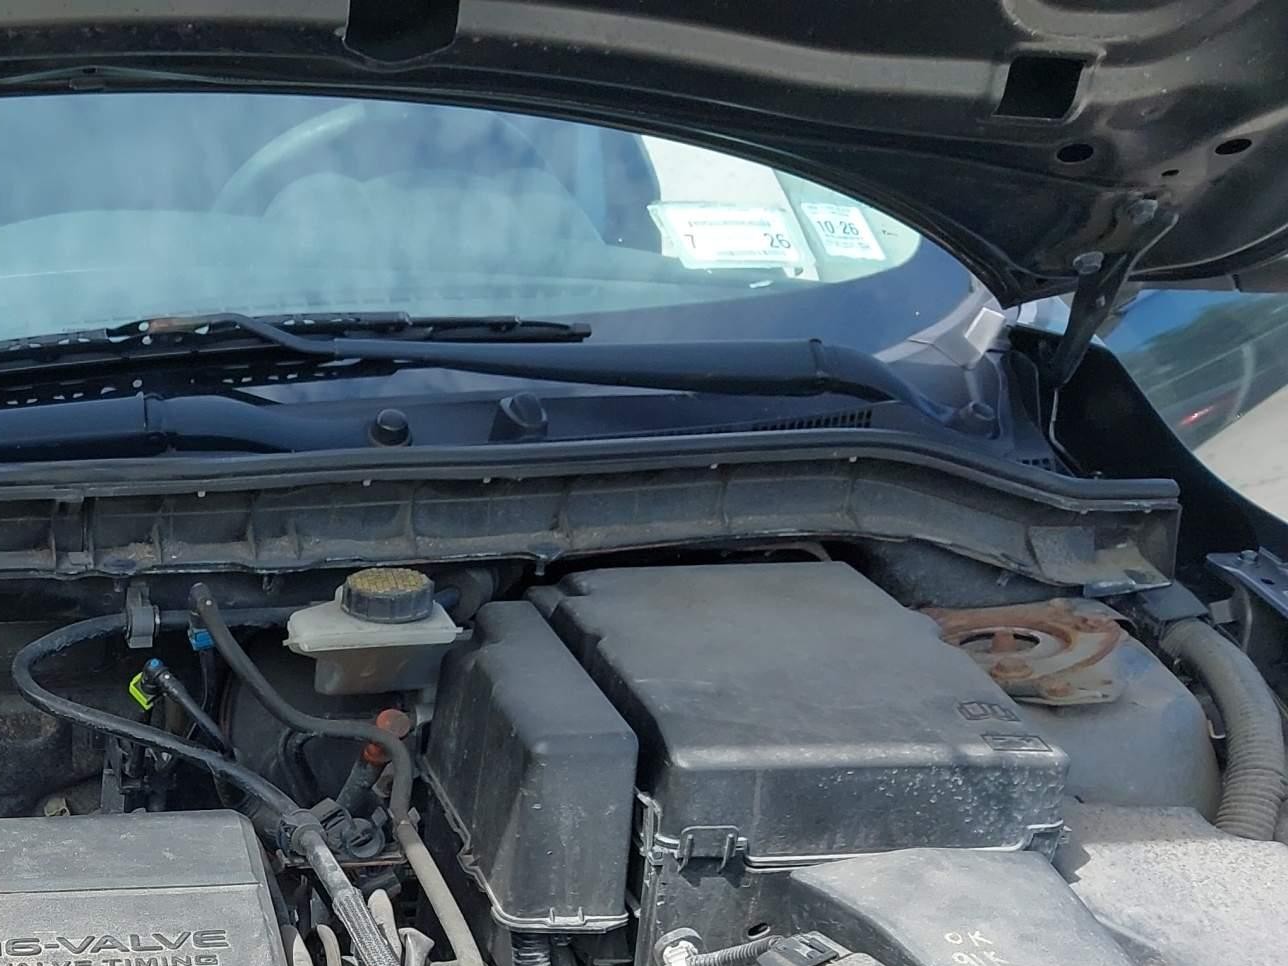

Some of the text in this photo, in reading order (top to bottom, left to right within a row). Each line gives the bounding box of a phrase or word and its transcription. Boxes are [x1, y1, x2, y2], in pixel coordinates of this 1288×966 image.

[817, 220, 860, 236] 10 26
[944, 930, 993, 947] OK
